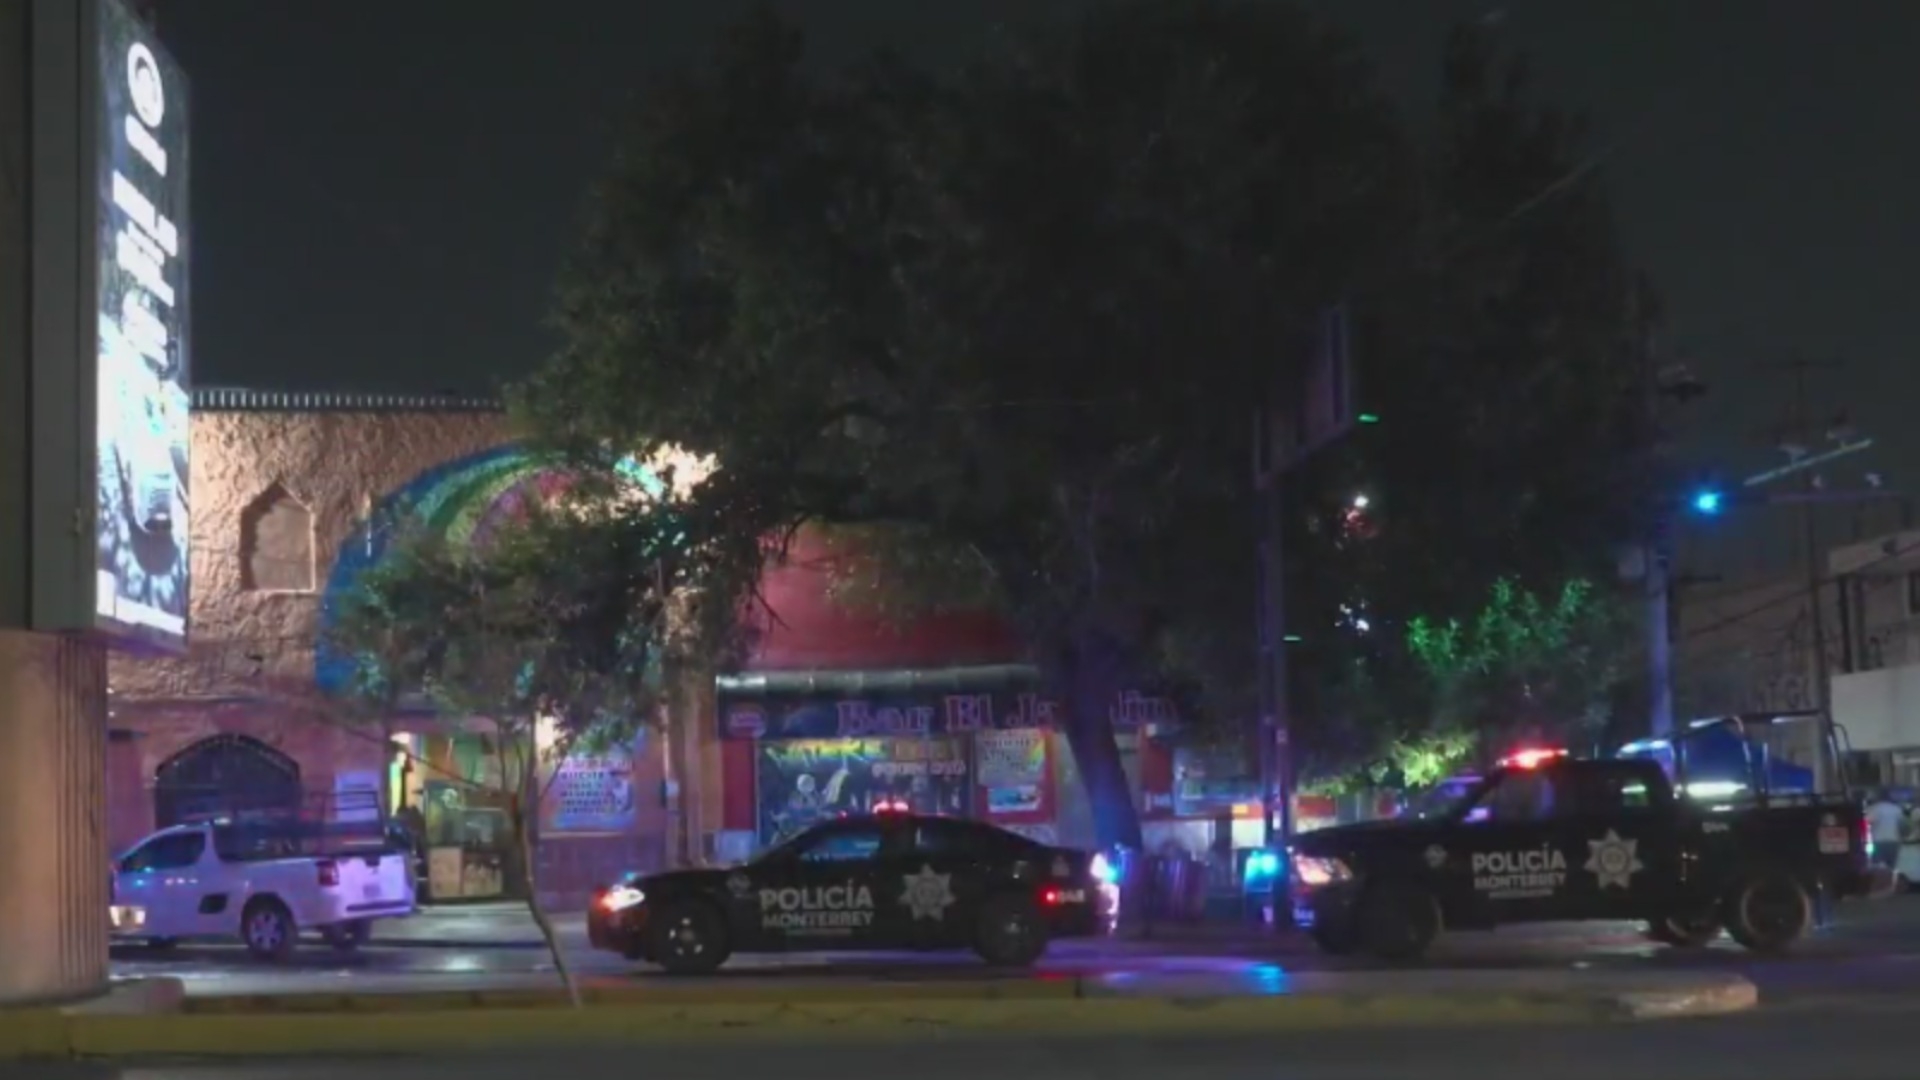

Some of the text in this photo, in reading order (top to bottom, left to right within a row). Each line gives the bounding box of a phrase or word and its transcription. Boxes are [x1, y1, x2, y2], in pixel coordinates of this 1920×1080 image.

[1471, 842, 1567, 874] POLICÍA
[1473, 872, 1566, 890] MONTERREY
[759, 878, 874, 911] POLICÍA
[762, 910, 874, 929] MONTERREY
